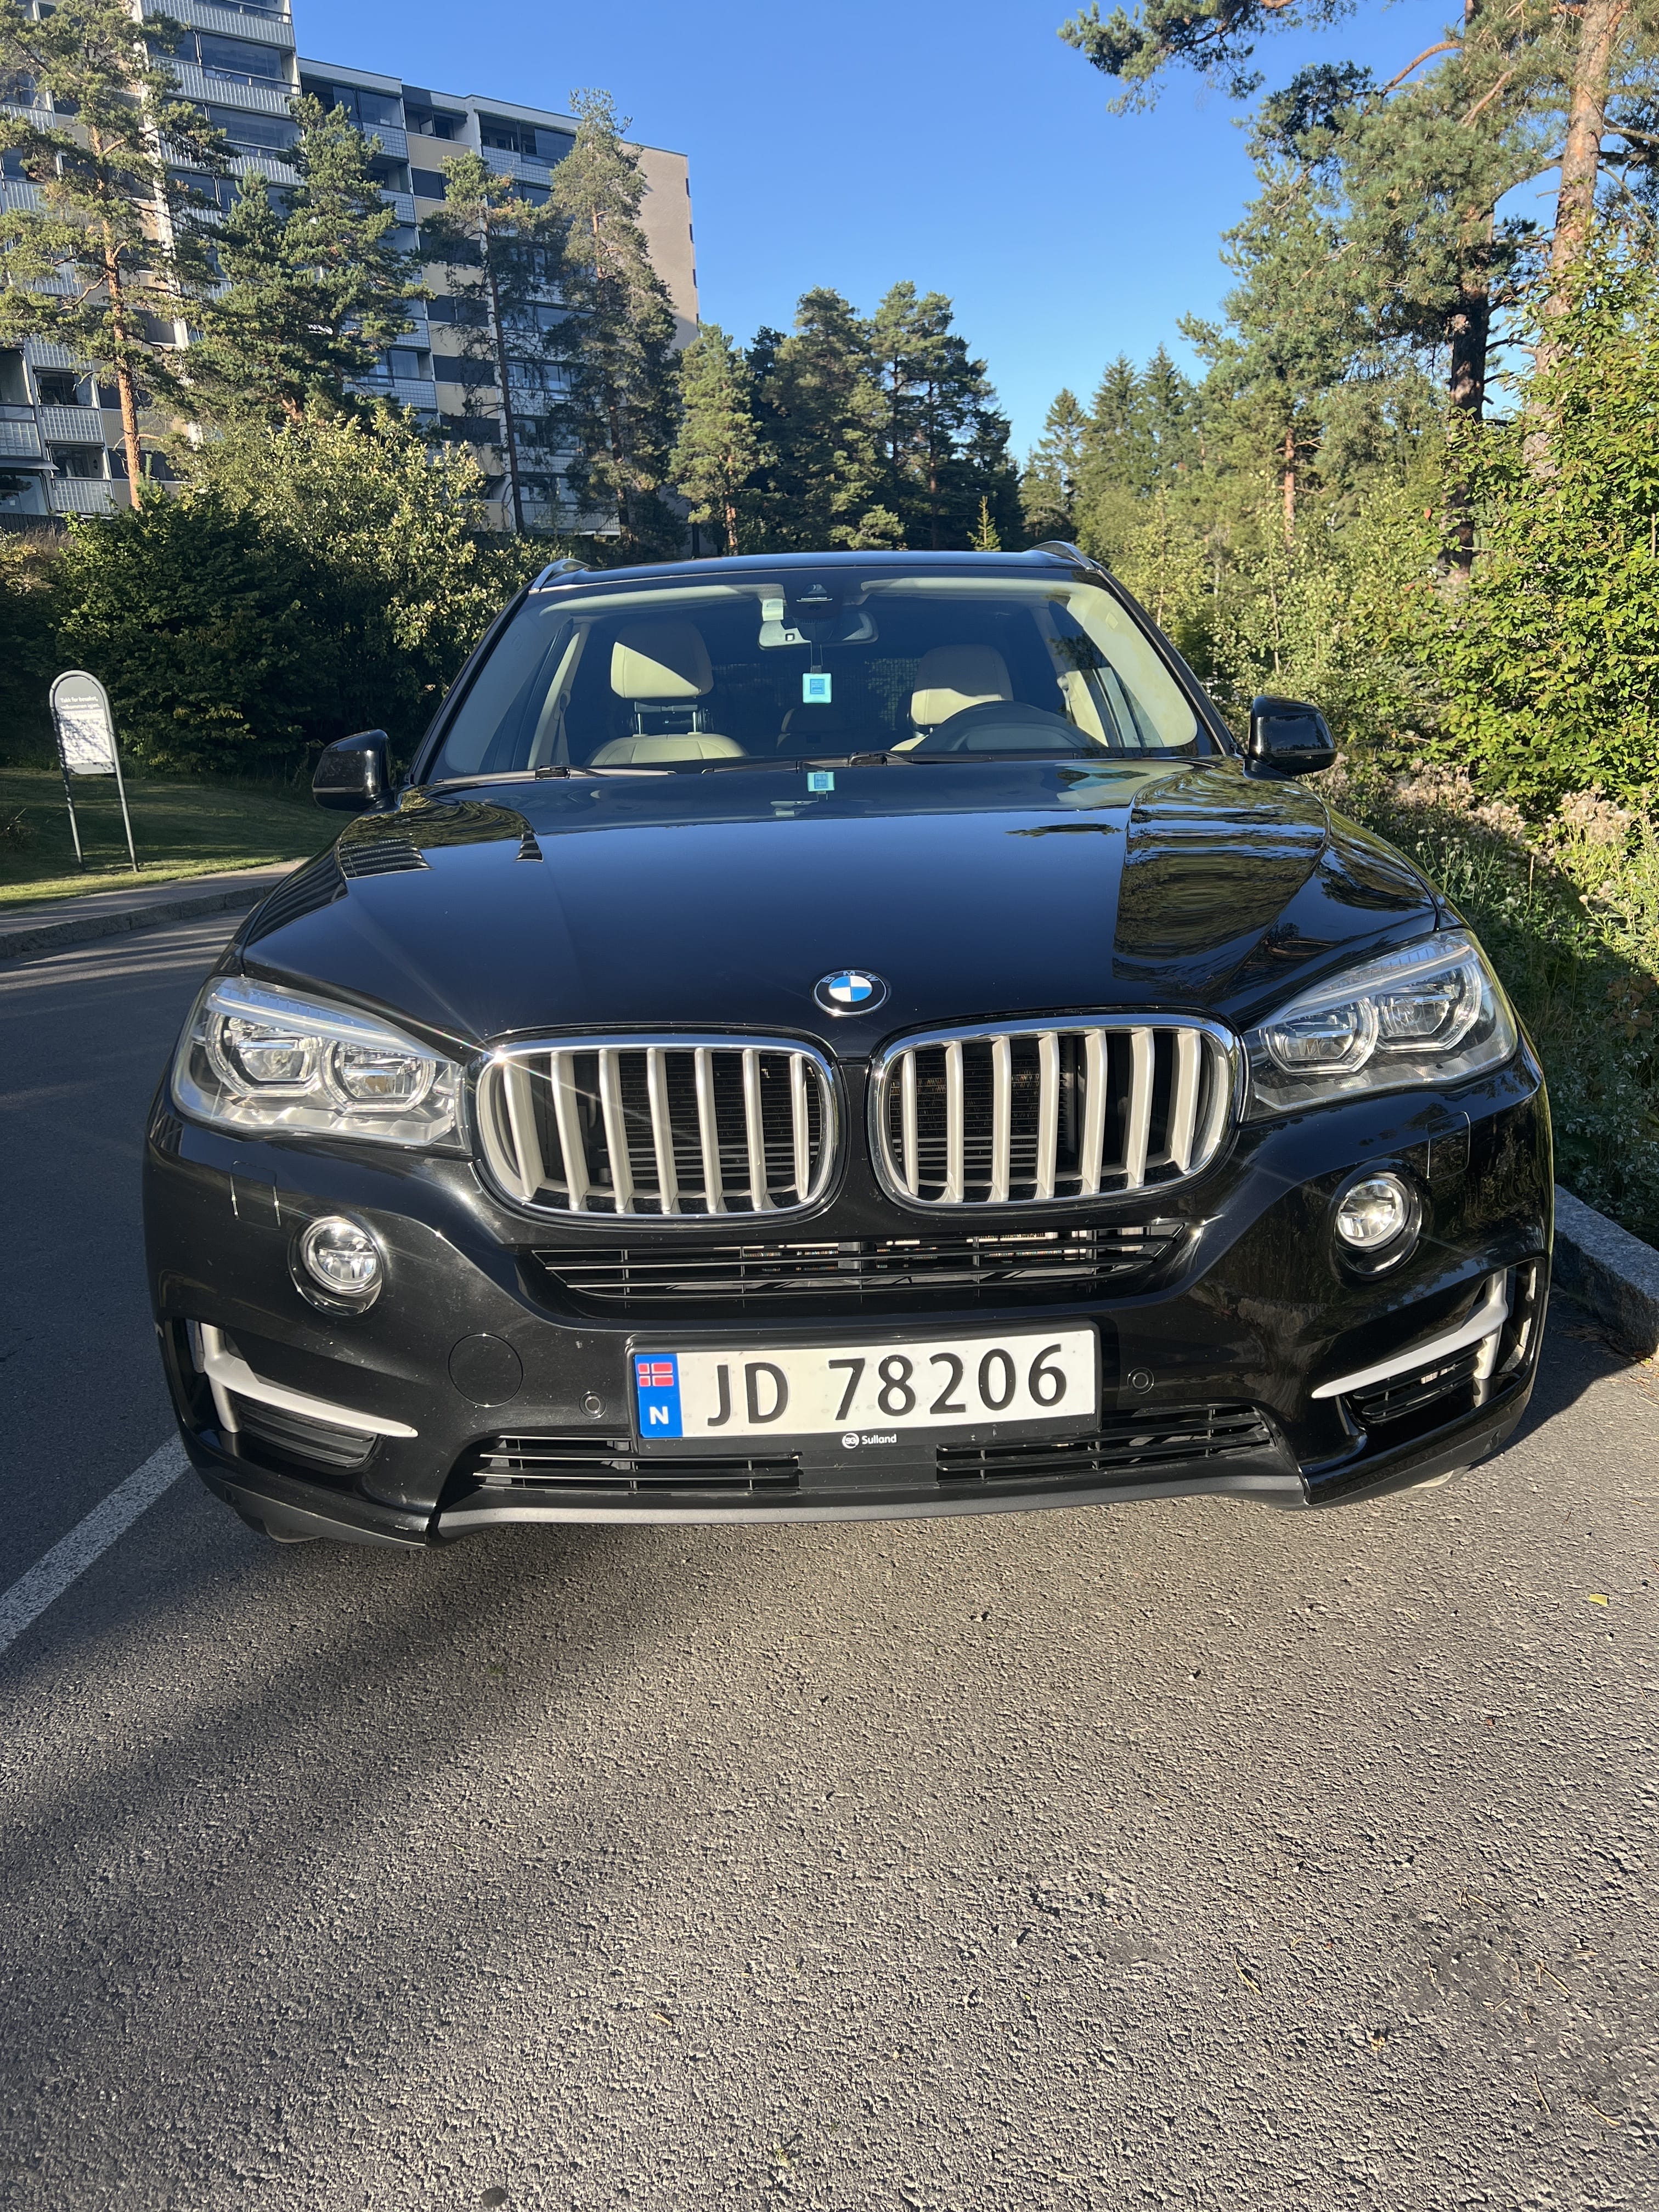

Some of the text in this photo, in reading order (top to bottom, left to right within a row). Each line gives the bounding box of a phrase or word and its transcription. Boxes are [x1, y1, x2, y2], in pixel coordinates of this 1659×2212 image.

[821, 970, 879, 984] BMW
[707, 1343, 1068, 1427] JD 78206
[649, 1406, 670, 1425] N
[861, 1434, 897, 1444] Sulland
